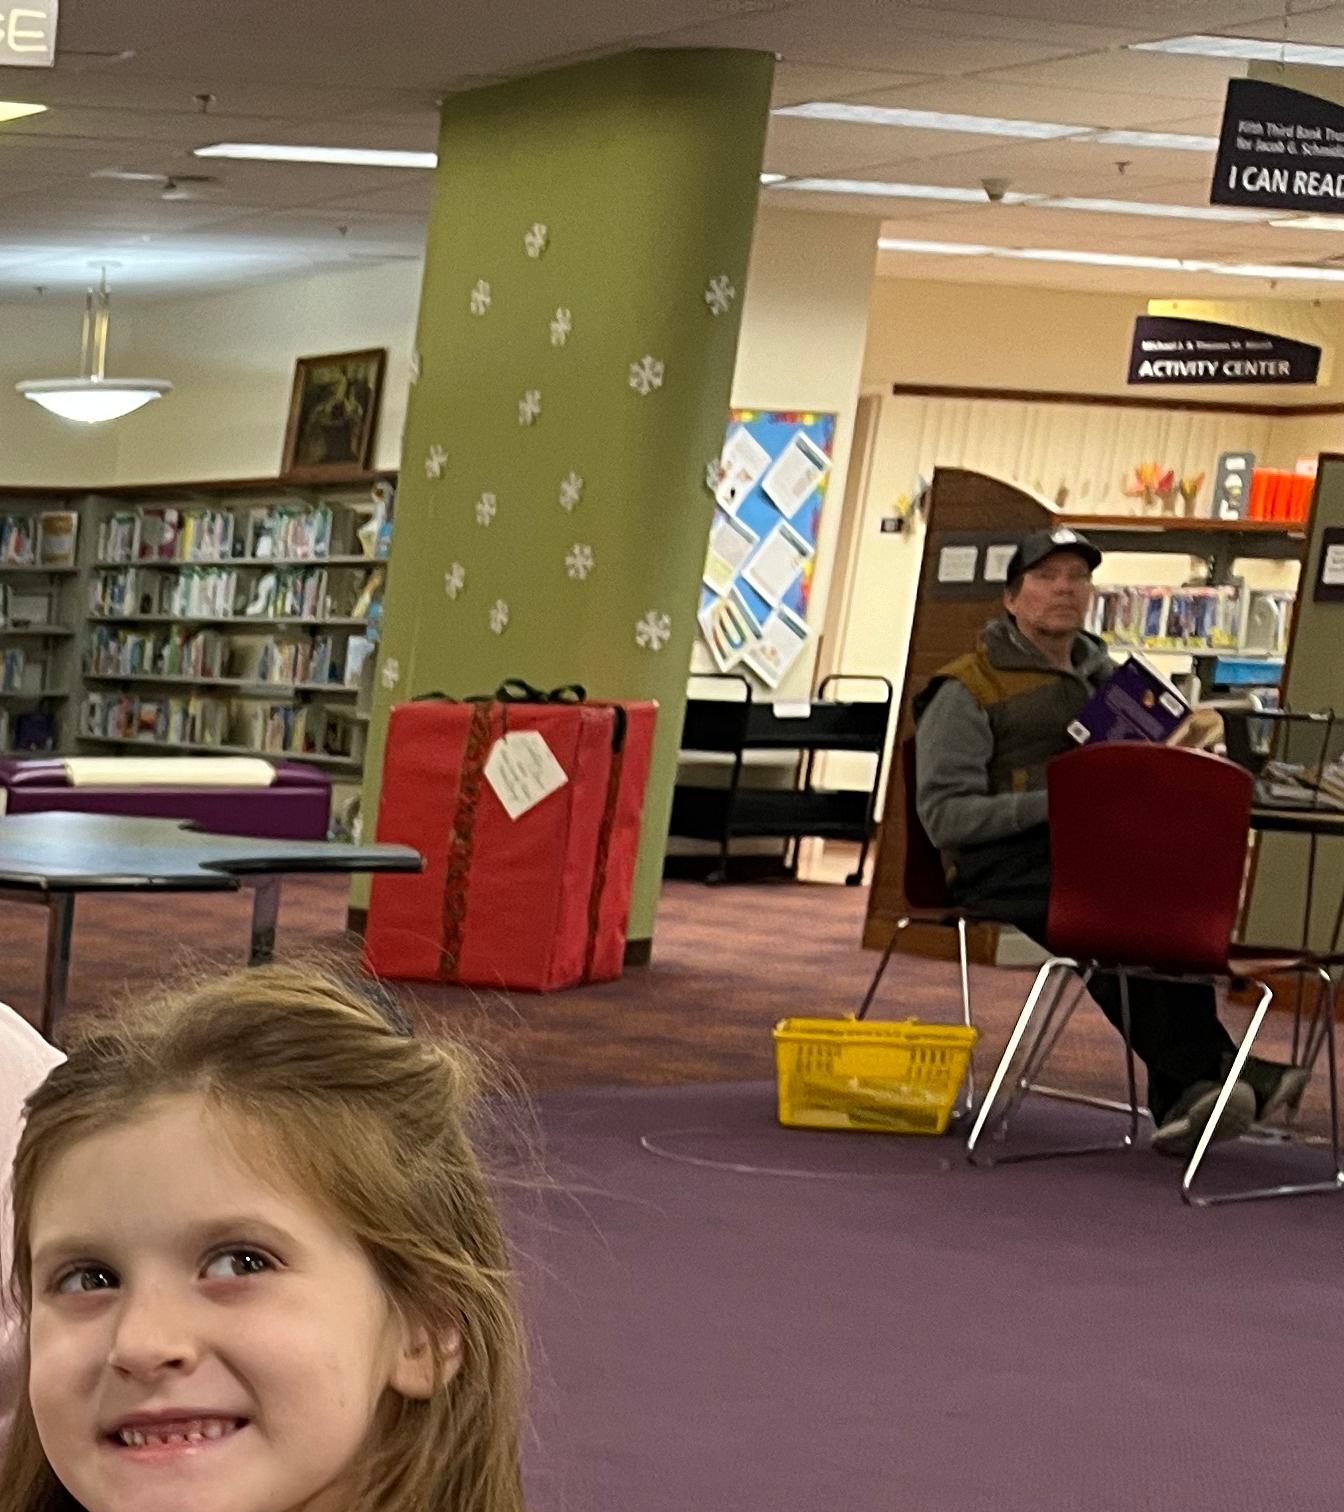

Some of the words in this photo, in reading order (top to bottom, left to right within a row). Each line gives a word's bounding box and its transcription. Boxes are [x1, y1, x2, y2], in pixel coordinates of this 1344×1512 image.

[1229, 165, 1238, 189] I
[1242, 166, 1289, 194] CAN
[1139, 360, 1218, 377] ACTIVITY
[1223, 360, 1290, 376] CENTER
